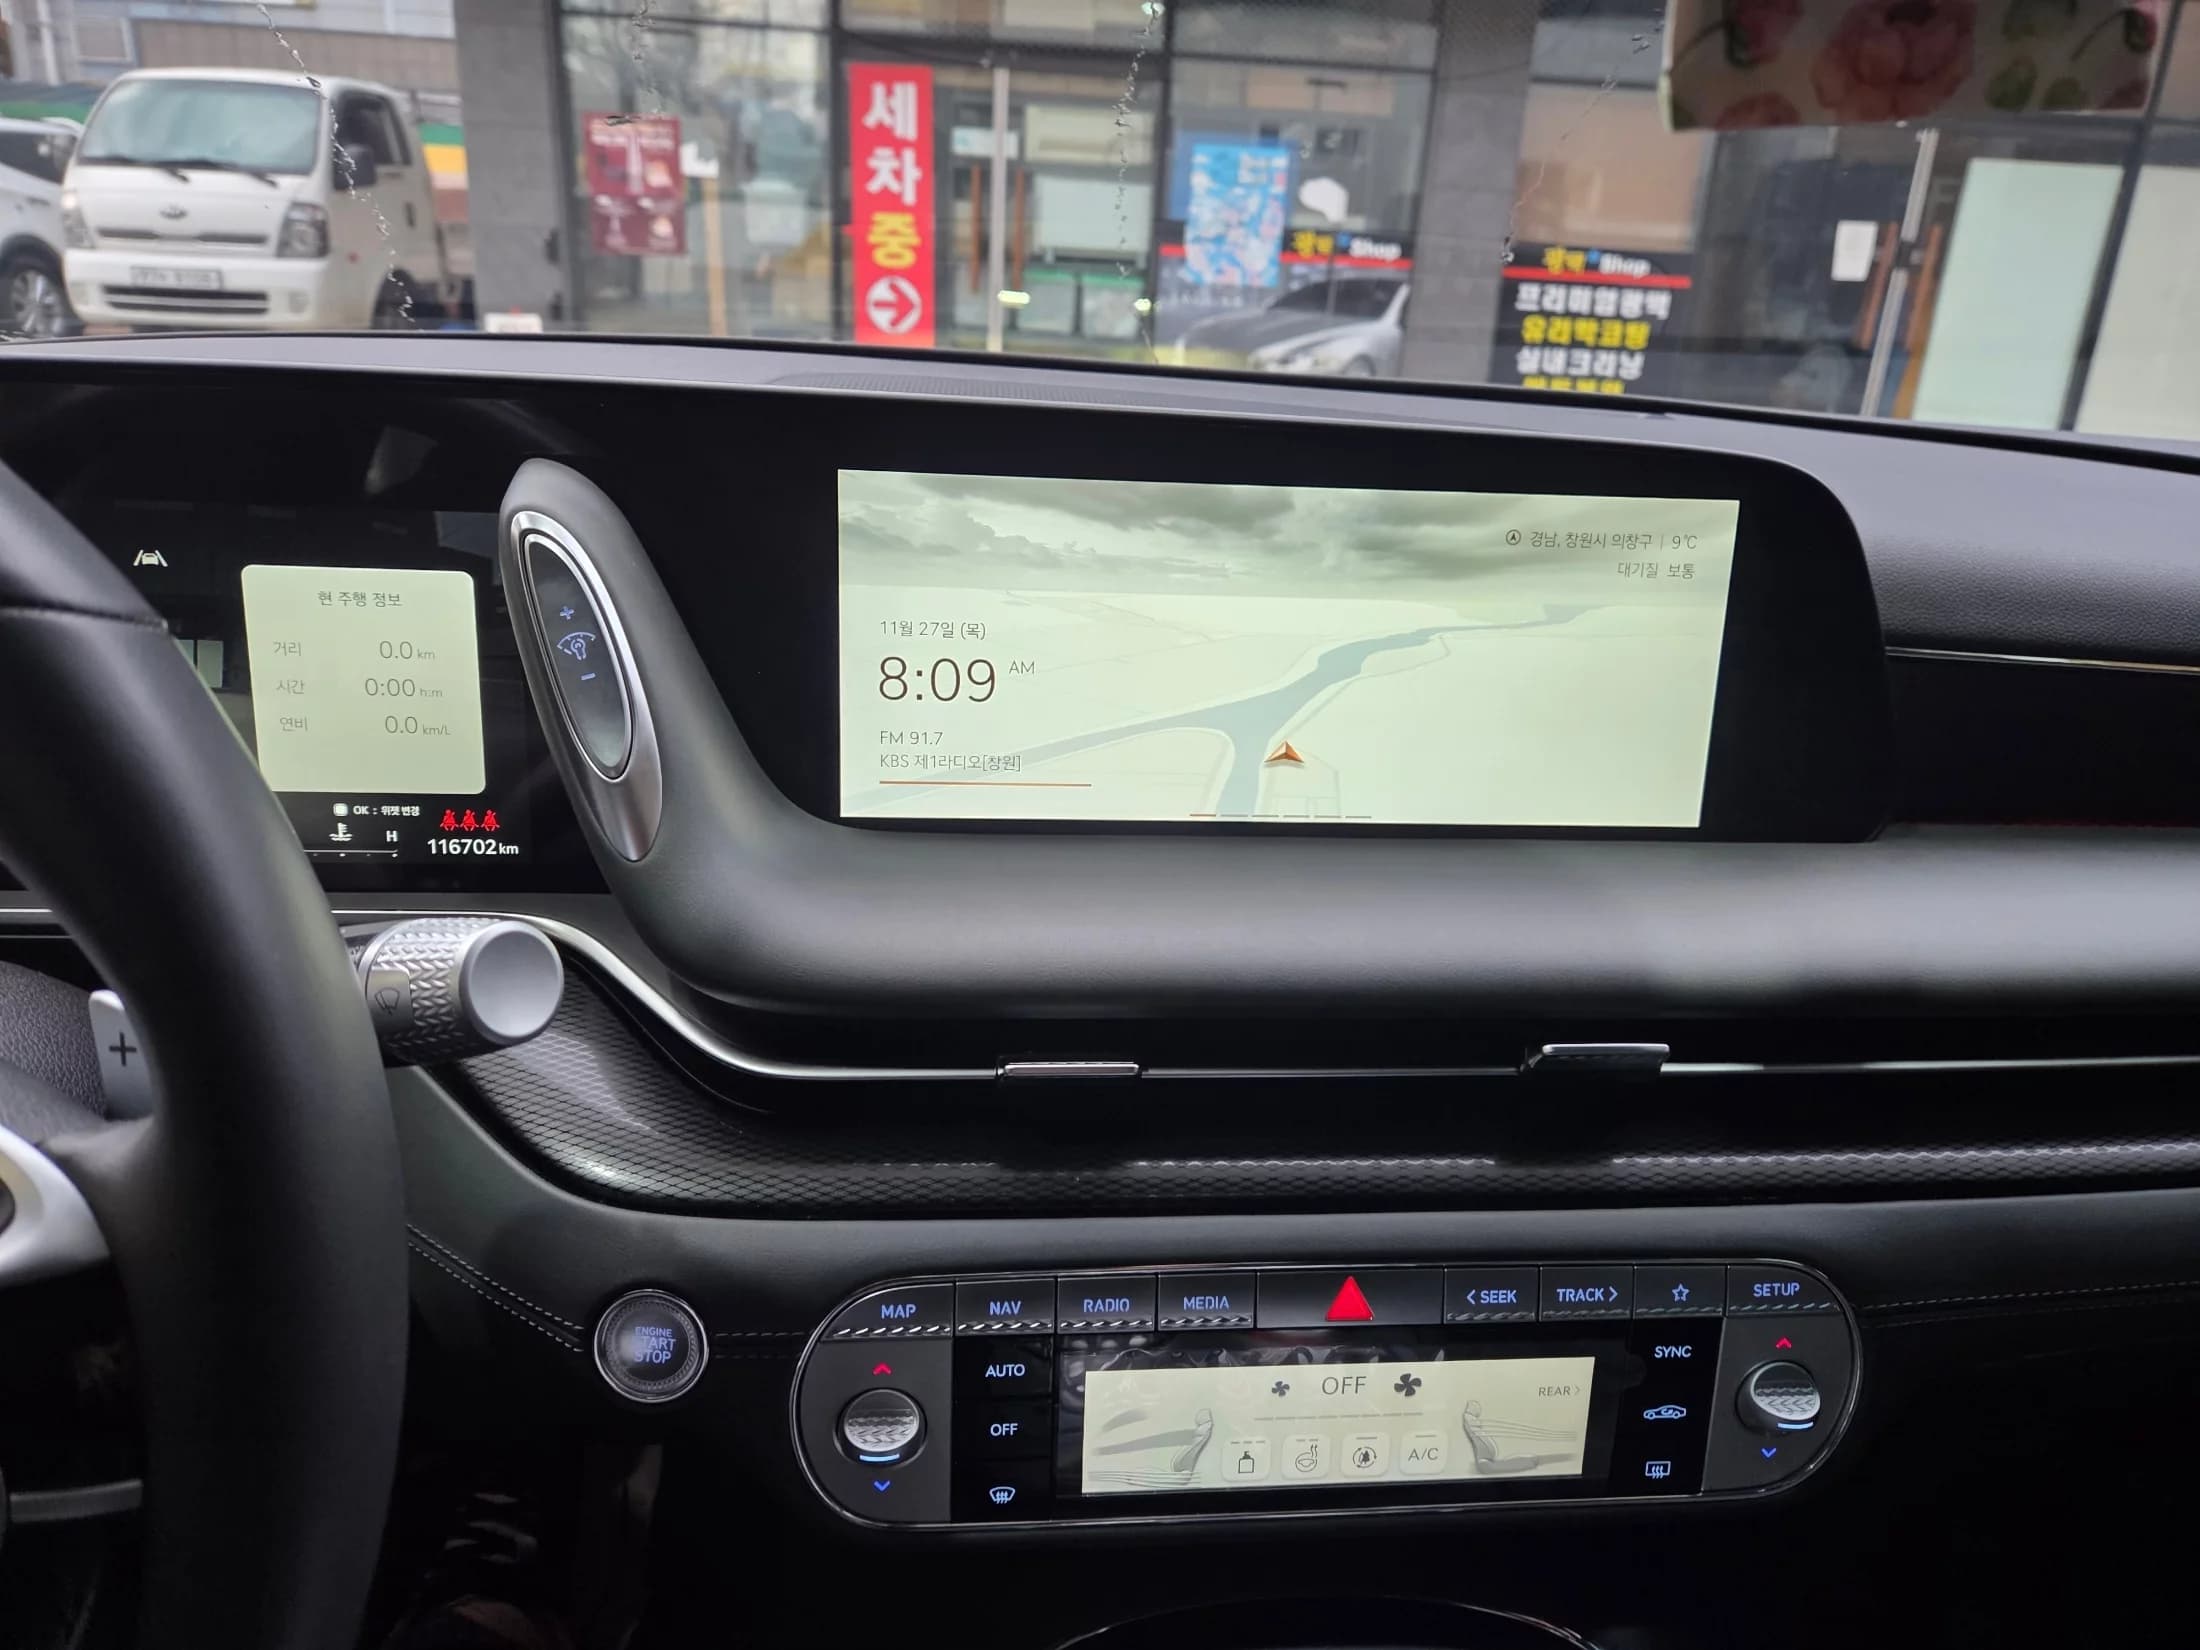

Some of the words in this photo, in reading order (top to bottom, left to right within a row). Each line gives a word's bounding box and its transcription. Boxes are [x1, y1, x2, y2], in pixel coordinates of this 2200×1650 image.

[861, 81, 924, 270] 세차중
[1349, 237, 1402, 263] Shop
[1599, 253, 1651, 279] Shop
[1529, 531, 1561, 548] 경남,
[1565, 532, 1606, 549] 창원시
[1611, 533, 1652, 550] 의창구
[1617, 562, 1658, 578] 대기질
[1667, 563, 1696, 580] 보통
[317, 591, 332, 606] 현
[338, 591, 367, 608] 주행
[372, 592, 403, 608] 정보
[880, 620, 913, 637] 11월
[919, 621, 954, 639] 27일
[960, 622, 986, 641] (목)
[273, 641, 302, 657] 거리
[379, 640, 413, 660] 0.0
[417, 648, 436, 660] km
[276, 679, 305, 695] 시간
[364, 678, 416, 697] 0:00
[879, 656, 995, 702] 8:09
[1008, 660, 1036, 675] AM
[279, 716, 309, 732] 연비
[385, 715, 418, 734] 0.0
[422, 724, 451, 736] km/L
[880, 731, 904, 745] FM
[909, 731, 944, 746] 91.7
[880, 754, 910, 769] KBS
[914, 754, 1022, 772] 제1라디오[창원]
[352, 805, 370, 815] OK
[380, 805, 400, 817] 위젯
[401, 805, 420, 817] 변경
[386, 830, 399, 843] H
[1480, 1289, 1517, 1304] SEEK
[1556, 1287, 1604, 1302] TRACK
[1752, 1282, 1801, 1298] SETUP
[989, 1300, 1022, 1317] NAV
[1082, 1297, 1131, 1314] RADIO
[1182, 1294, 1230, 1311] MEDIA
[880, 1303, 917, 1320] MAP
[635, 1326, 672, 1337] ENGINE
[632, 1336, 676, 1351] TART
[1653, 1344, 1693, 1360] SYNC
[634, 1350, 672, 1364] STOP
[985, 1363, 1026, 1379] AUTO
[1321, 1375, 1368, 1396] OFF
[1537, 1385, 1572, 1398] REAR
[989, 1422, 1019, 1437] OFF
[1407, 1447, 1440, 1462] A/C
